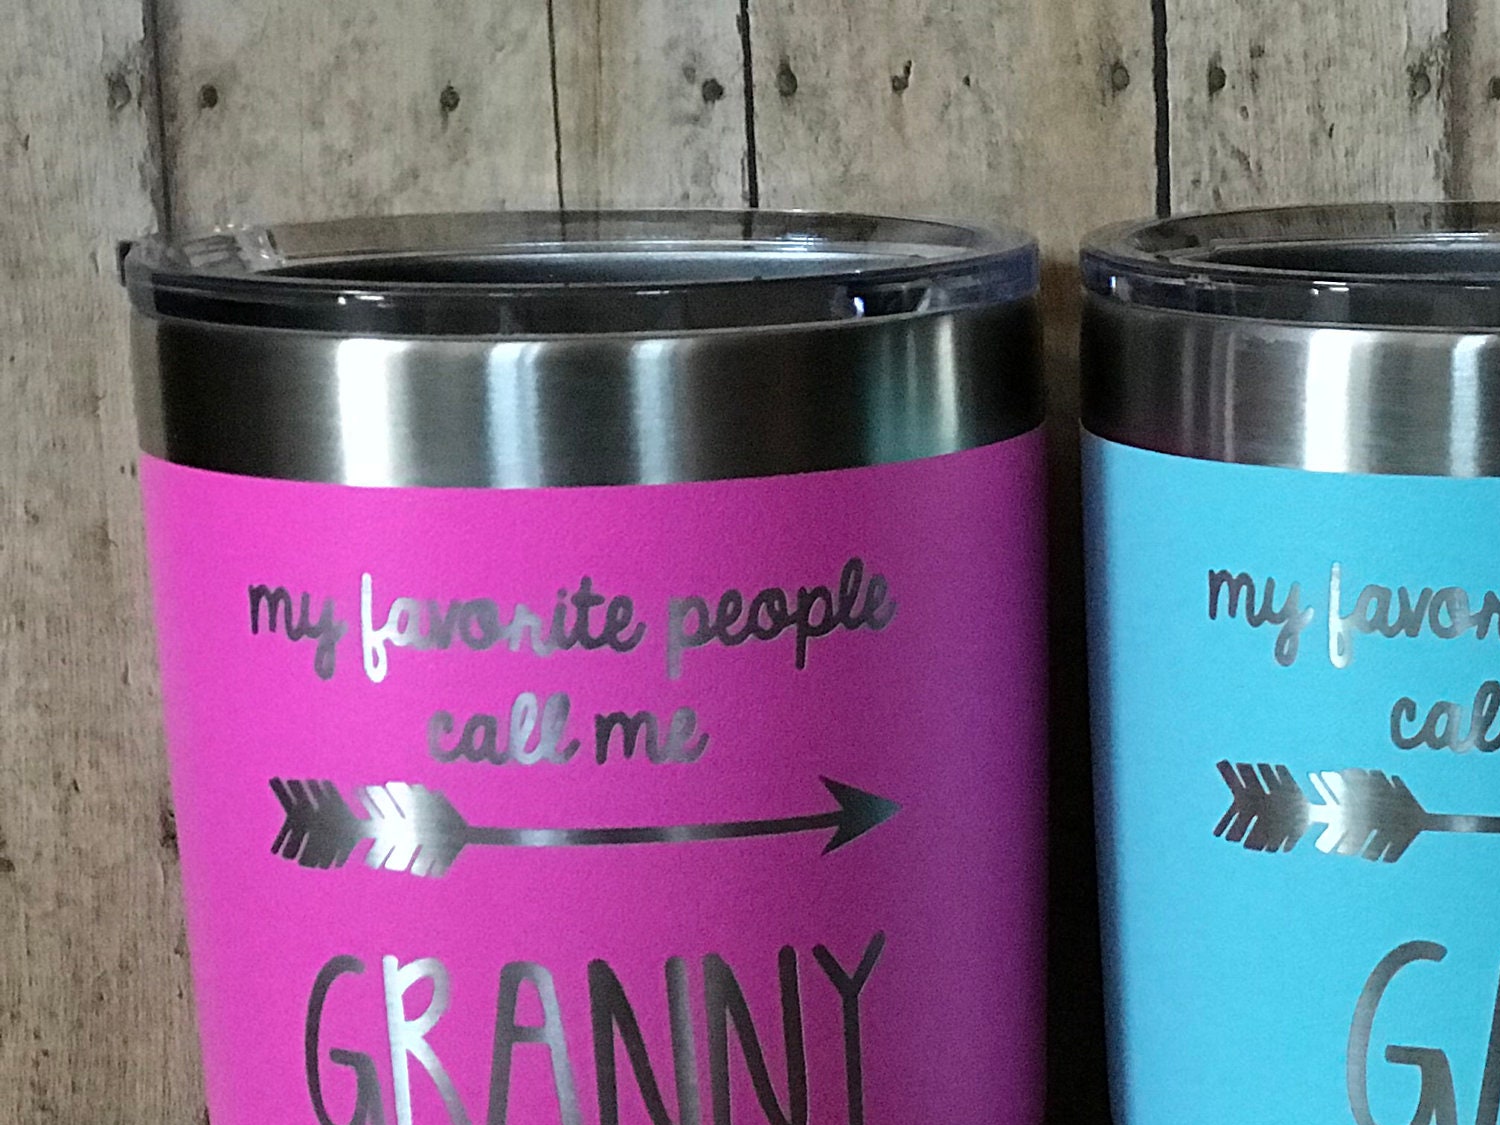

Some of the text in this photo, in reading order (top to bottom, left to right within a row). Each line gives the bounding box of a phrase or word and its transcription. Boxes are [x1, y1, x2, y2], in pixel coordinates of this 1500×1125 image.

[248, 557, 898, 683] my favorite people
[1207, 568, 1314, 667] my
[426, 692, 710, 765] call me
